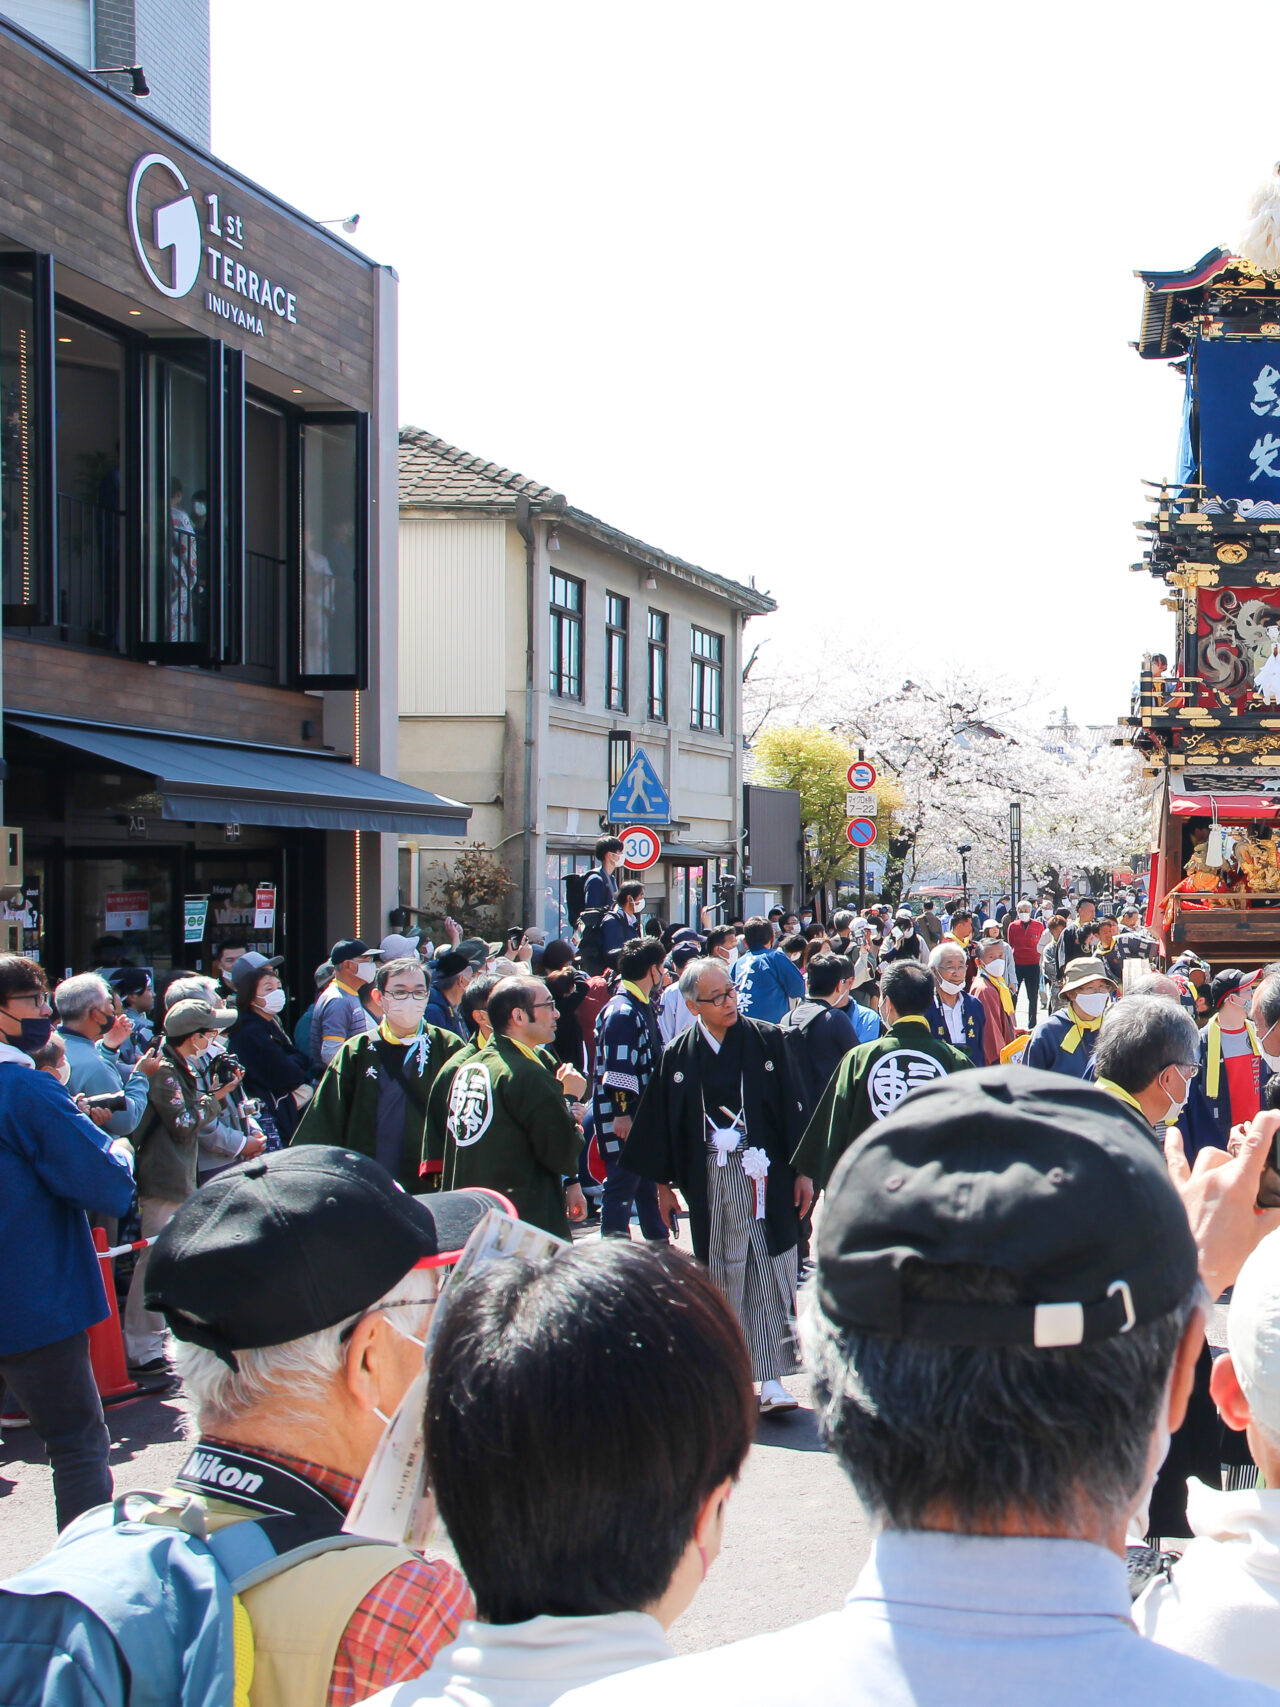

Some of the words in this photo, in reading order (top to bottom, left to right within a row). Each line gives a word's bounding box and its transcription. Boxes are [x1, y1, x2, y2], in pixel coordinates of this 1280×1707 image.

[206, 193, 244, 242] 1st
[206, 246, 298, 324] TERRACE
[206, 292, 265, 337] INUYAMA
[625, 838, 651, 858] 30
[1250, 1056, 1261, 1096] NIKE
[182, 1451, 264, 1494] Nikon
